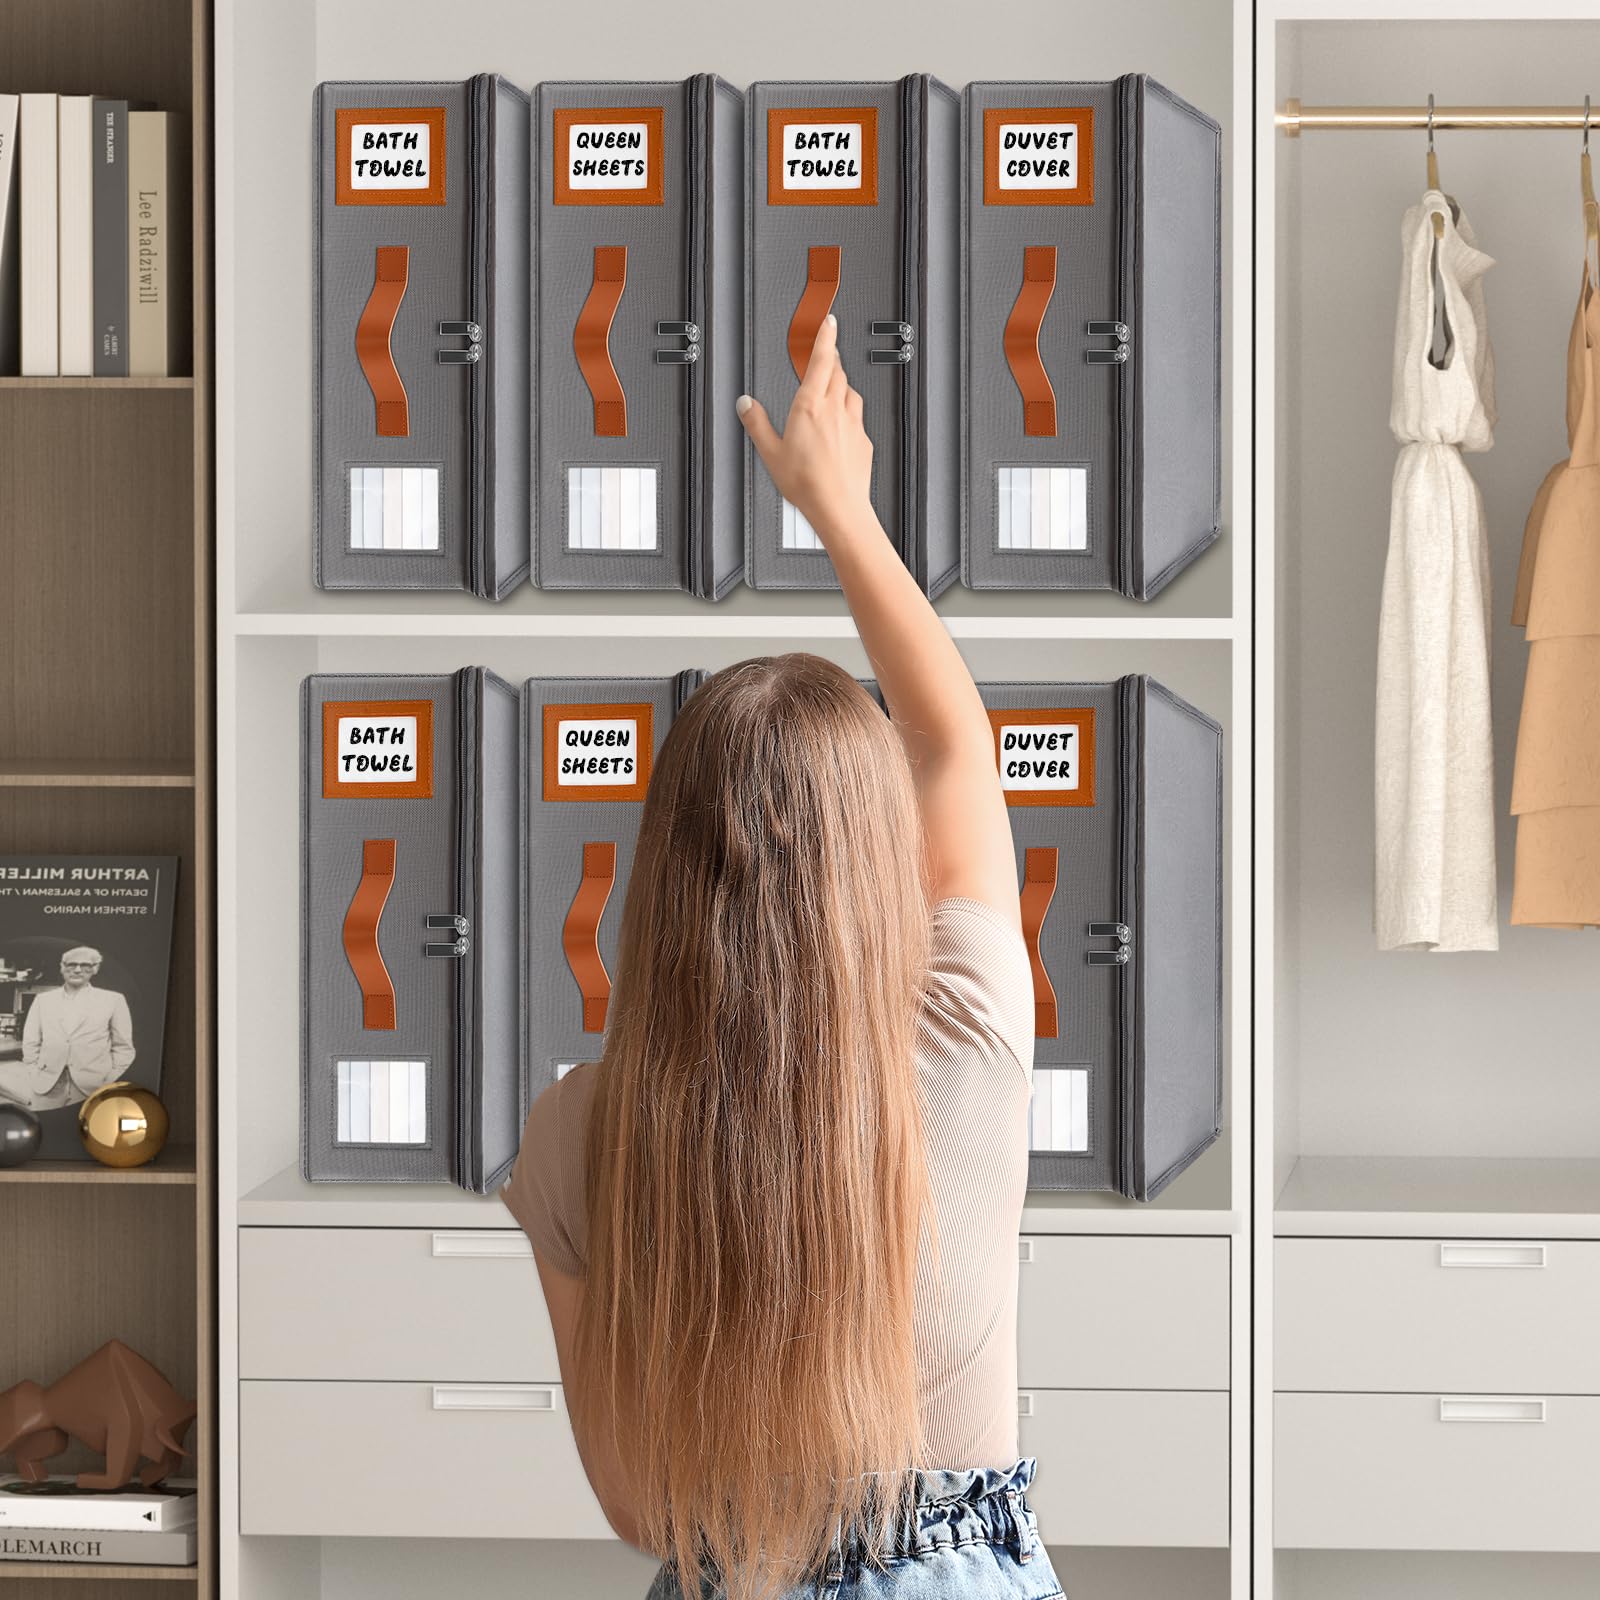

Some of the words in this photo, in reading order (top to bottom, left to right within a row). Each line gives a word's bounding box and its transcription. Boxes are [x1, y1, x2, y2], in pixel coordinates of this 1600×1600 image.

[106, 112, 114, 126] THE
[106, 127, 114, 163] STRANGER
[362, 131, 419, 150] BATH
[576, 131, 641, 150] QUEEN
[794, 131, 851, 150] BATH
[1003, 131, 1074, 150] DUVET
[354, 159, 427, 178] TOWEL
[572, 159, 645, 177] SHEETS
[786, 159, 859, 178] TOWEL
[1006, 159, 1070, 178] COVER
[139, 191, 158, 219] Lee
[139, 226, 159, 304] Radziwill
[349, 726, 406, 745] BATH
[565, 729, 630, 748] QUEEN
[1003, 732, 1074, 751] DUVET
[341, 754, 414, 773] TOWEL
[561, 757, 634, 776] SHEETS
[1006, 760, 1070, 779] COVER
[0, 1538, 102, 1556] LEMARCH
